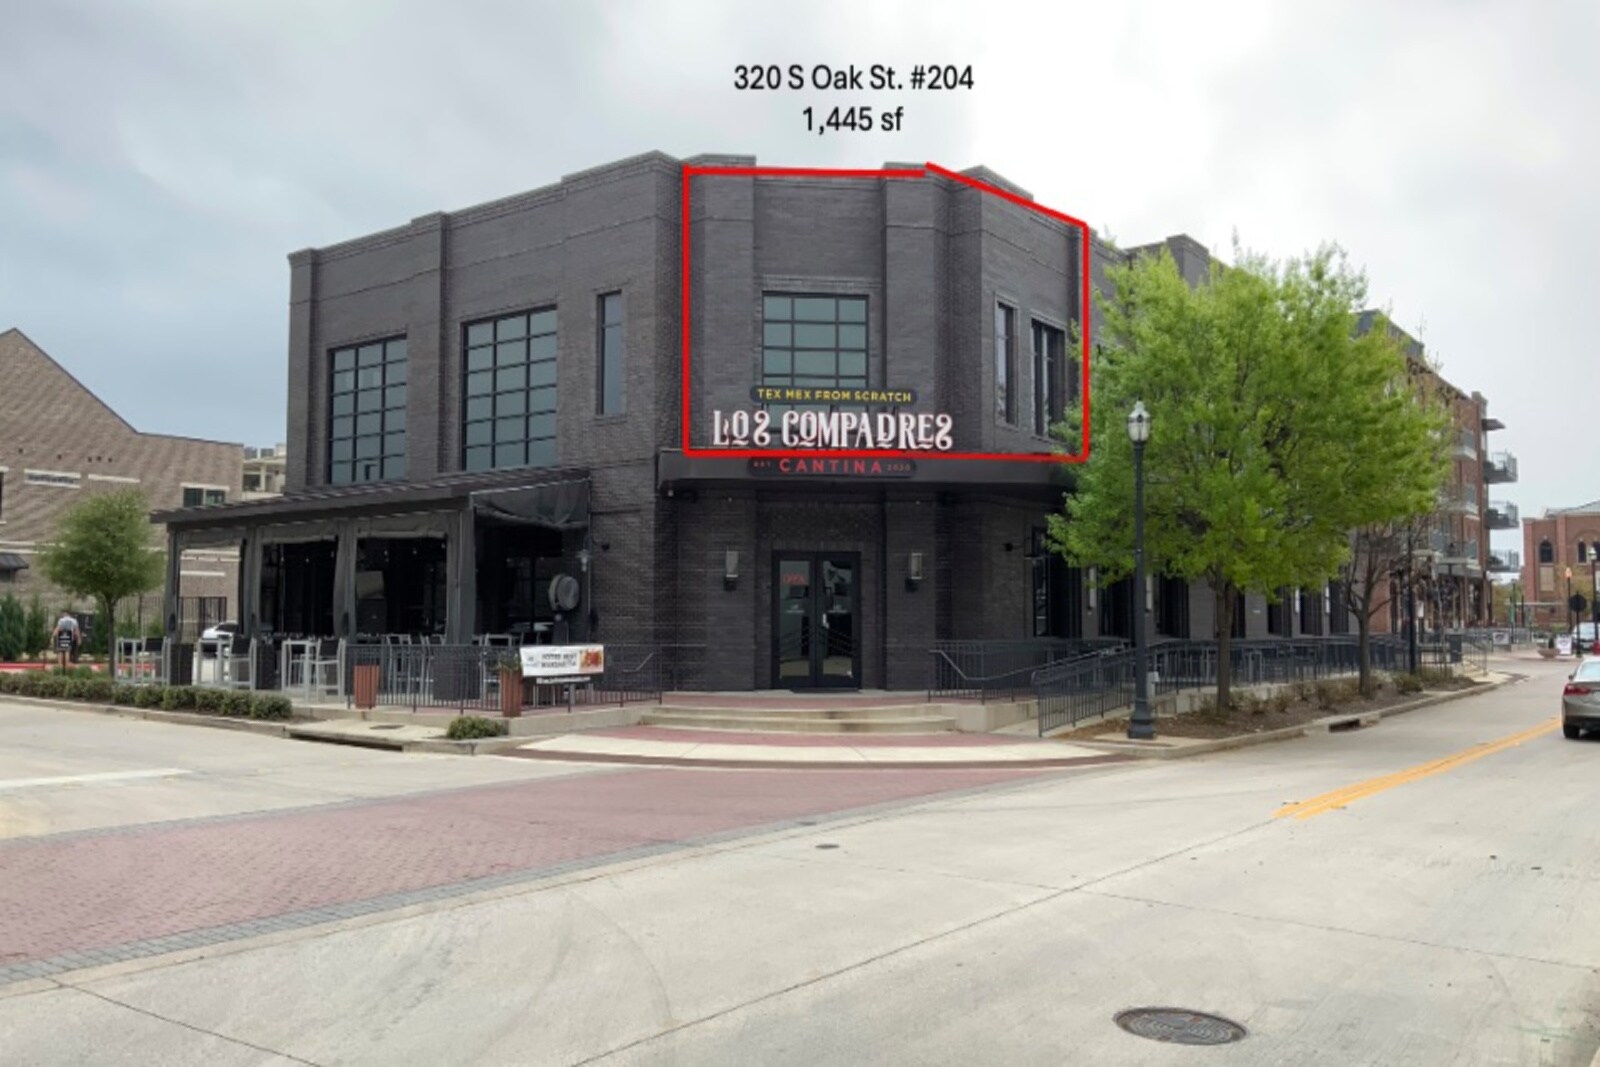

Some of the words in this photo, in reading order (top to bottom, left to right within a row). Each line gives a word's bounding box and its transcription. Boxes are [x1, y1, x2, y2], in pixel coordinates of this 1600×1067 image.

[757, 389, 781, 399] TEX
[786, 390, 812, 400] MEX
[815, 390, 850, 400] FROM
[854, 391, 912, 402] SCRATCH
[713, 410, 771, 446] LOS
[782, 410, 953, 450] COMPADRES
[779, 458, 882, 474] CANTINA
